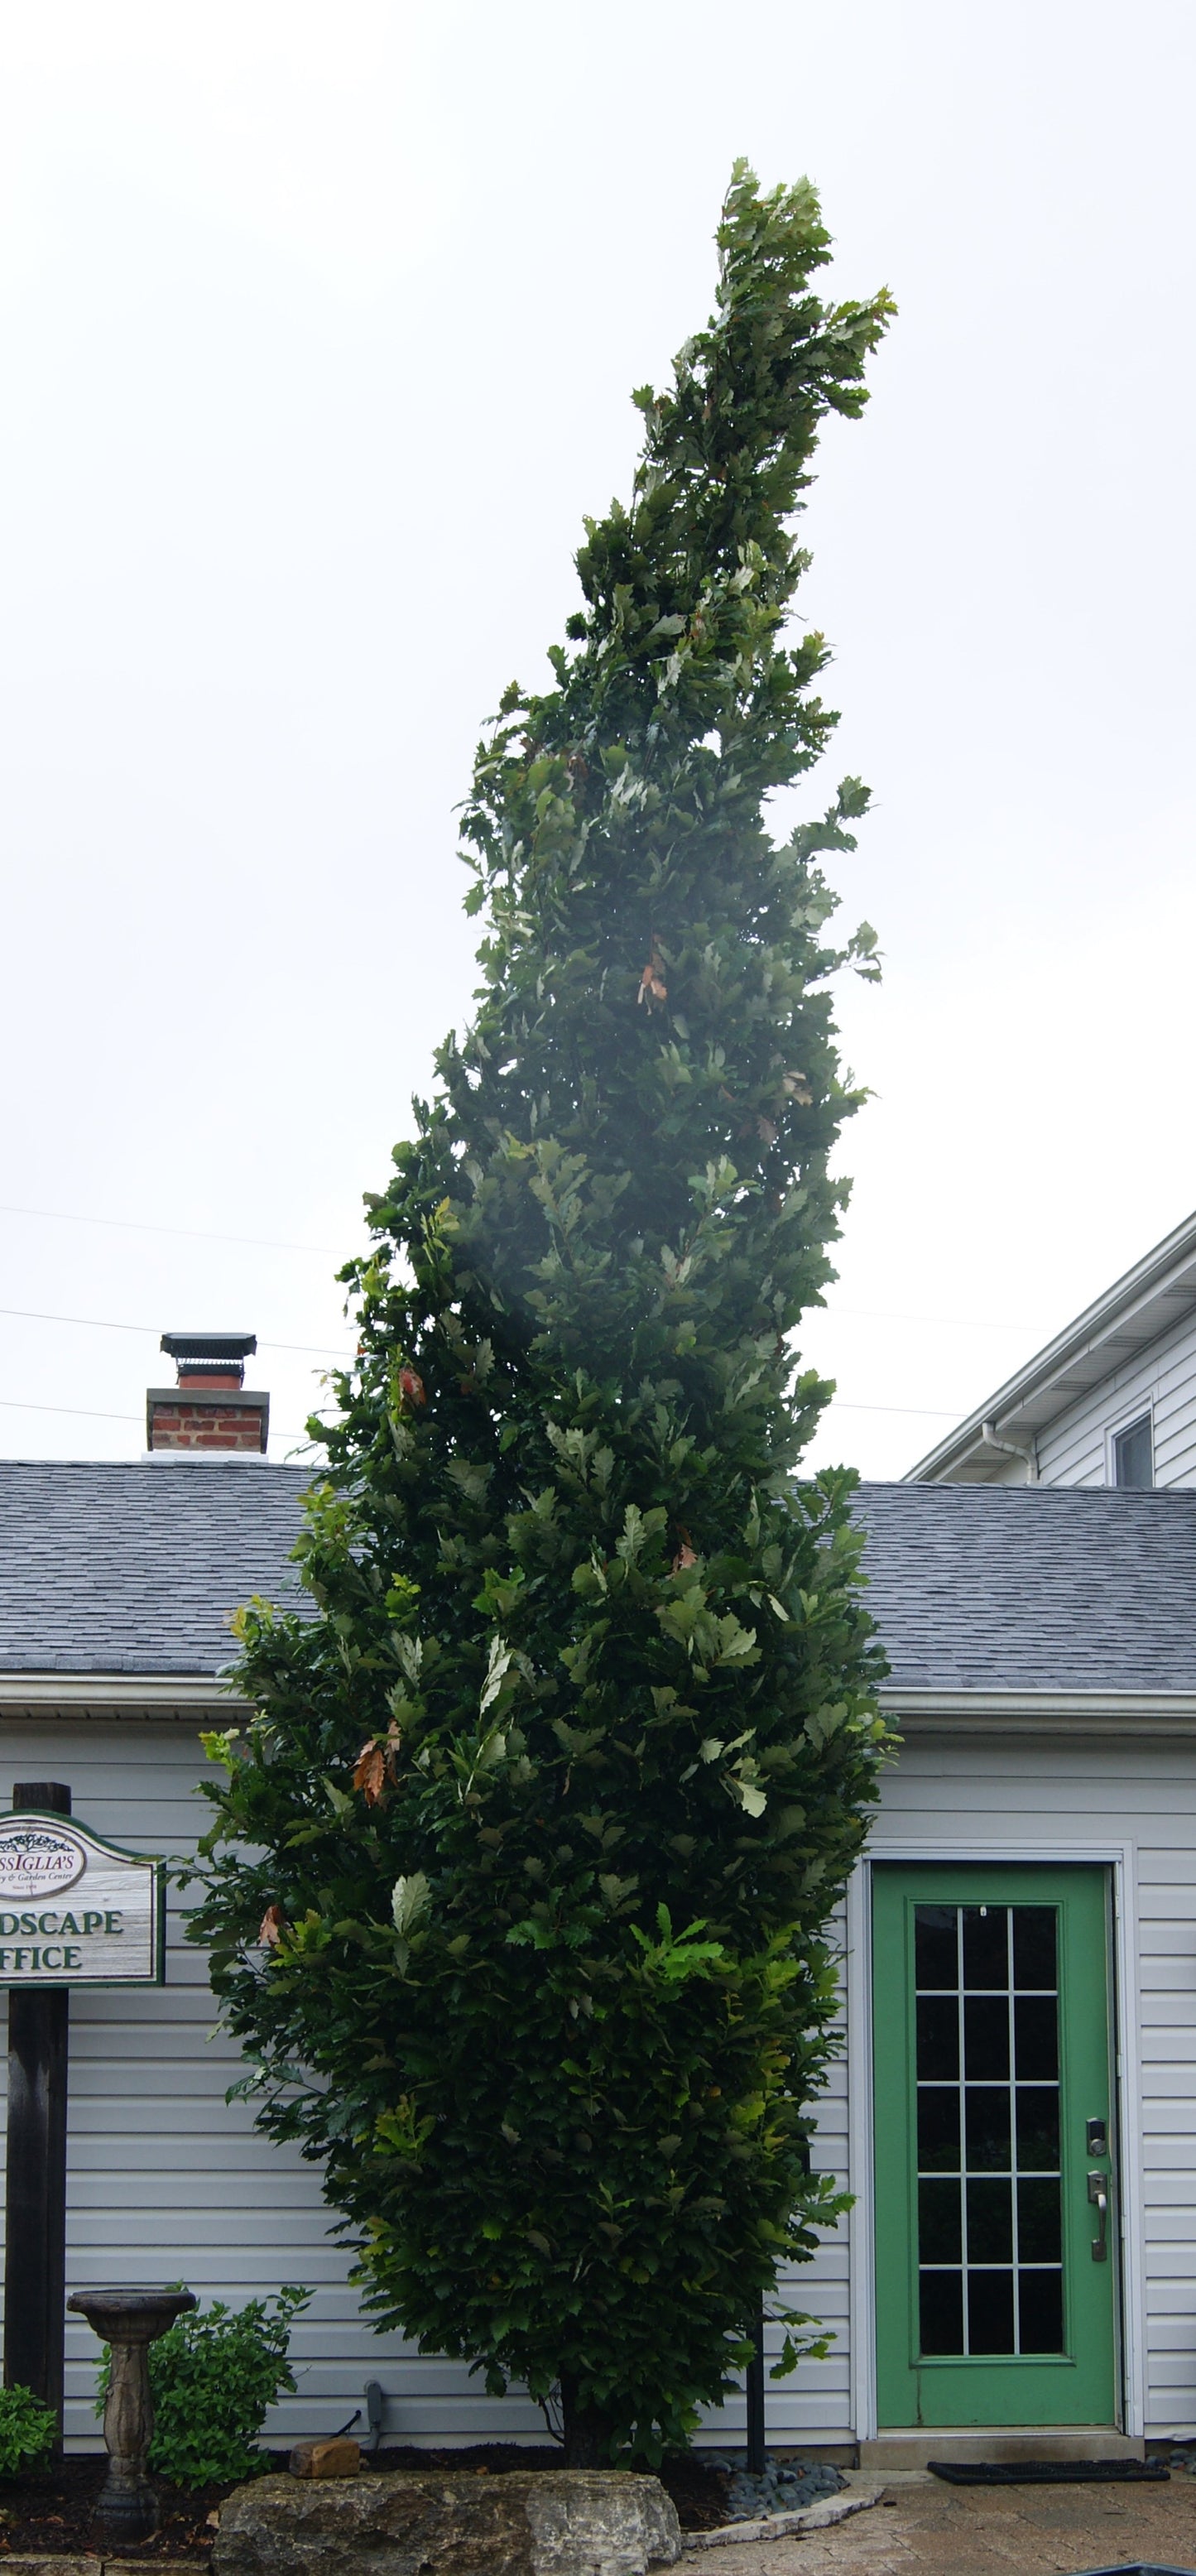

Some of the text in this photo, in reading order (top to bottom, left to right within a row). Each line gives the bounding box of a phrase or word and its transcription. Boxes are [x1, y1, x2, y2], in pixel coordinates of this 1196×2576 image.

[17, 1872, 46, 1881] Garden
[0, 1910, 124, 1935] DSCAPE
[0, 1946, 83, 1970] FFICE
